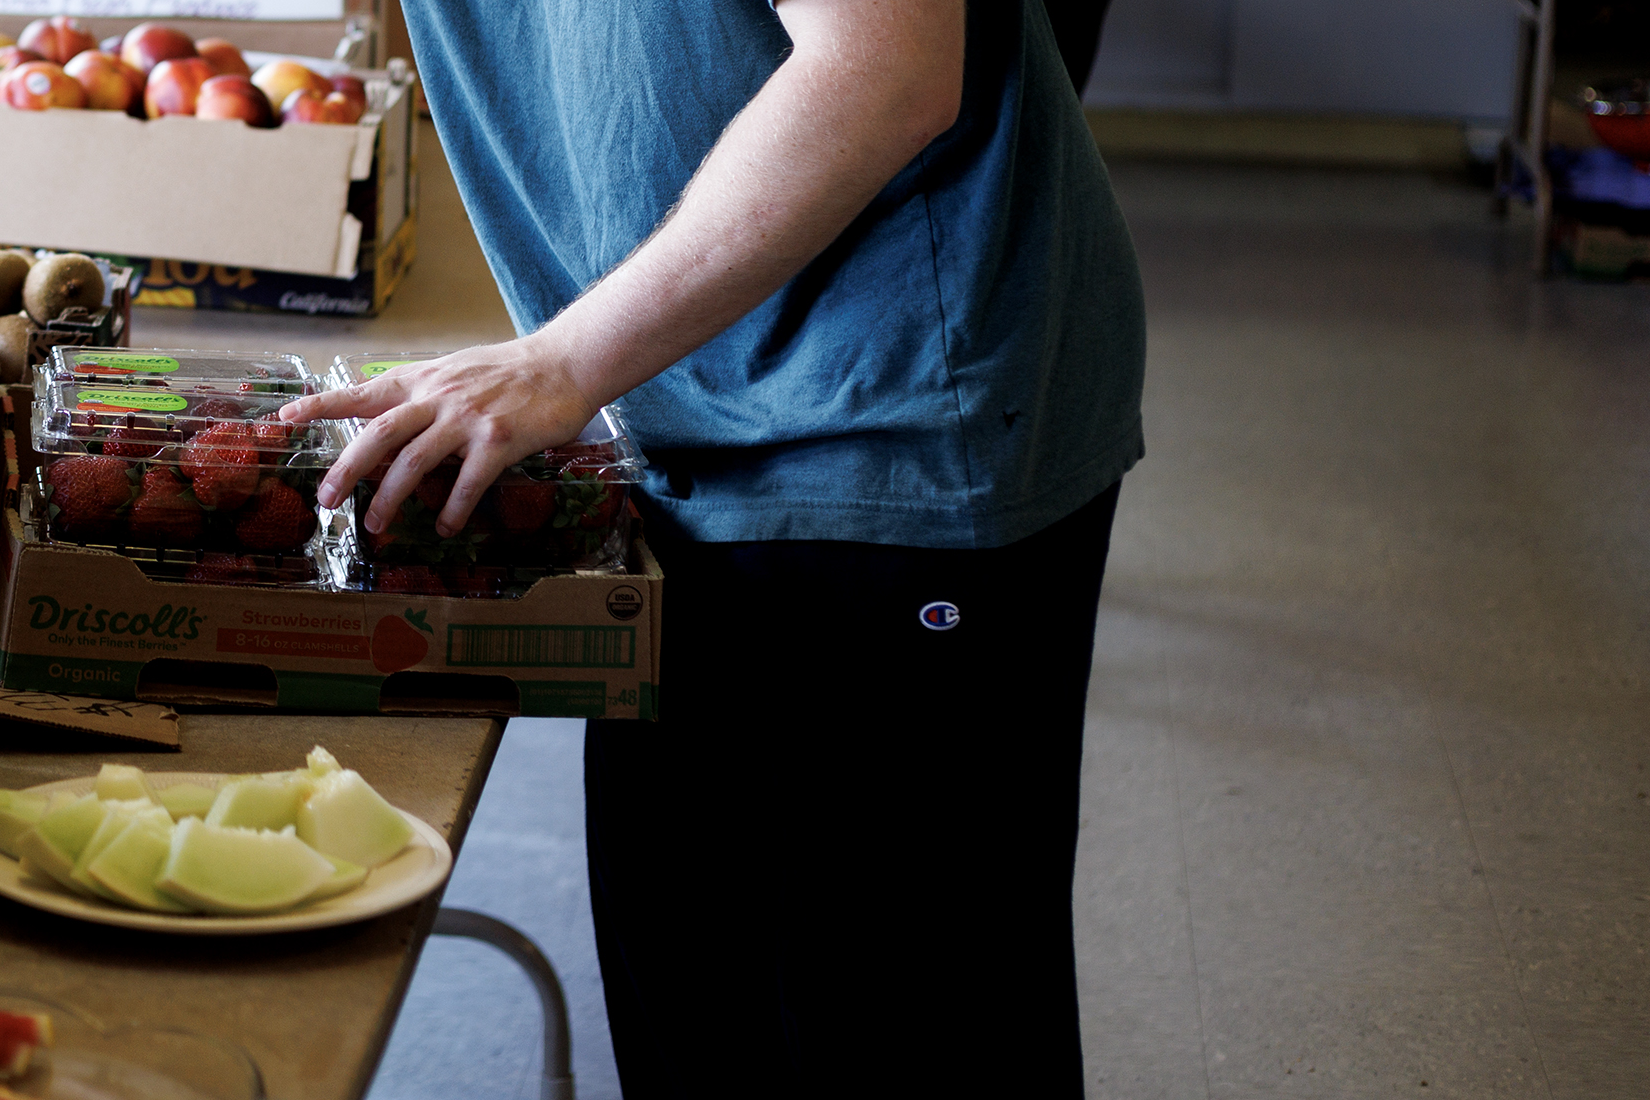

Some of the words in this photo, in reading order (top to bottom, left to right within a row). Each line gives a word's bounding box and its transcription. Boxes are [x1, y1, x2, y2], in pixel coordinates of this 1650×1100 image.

[615, 593, 635, 602] USDA
[28, 595, 204, 640] Driscoll's
[241, 609, 362, 630] Strawberries
[48, 632, 75, 647] Only
[77, 635, 97, 647] the
[99, 637, 135, 649] Finest
[138, 639, 179, 651] Berries
[235, 632, 271, 648] 8-16
[290, 641, 360, 653] CLAMSHELLS
[48, 662, 121, 683] Organic
